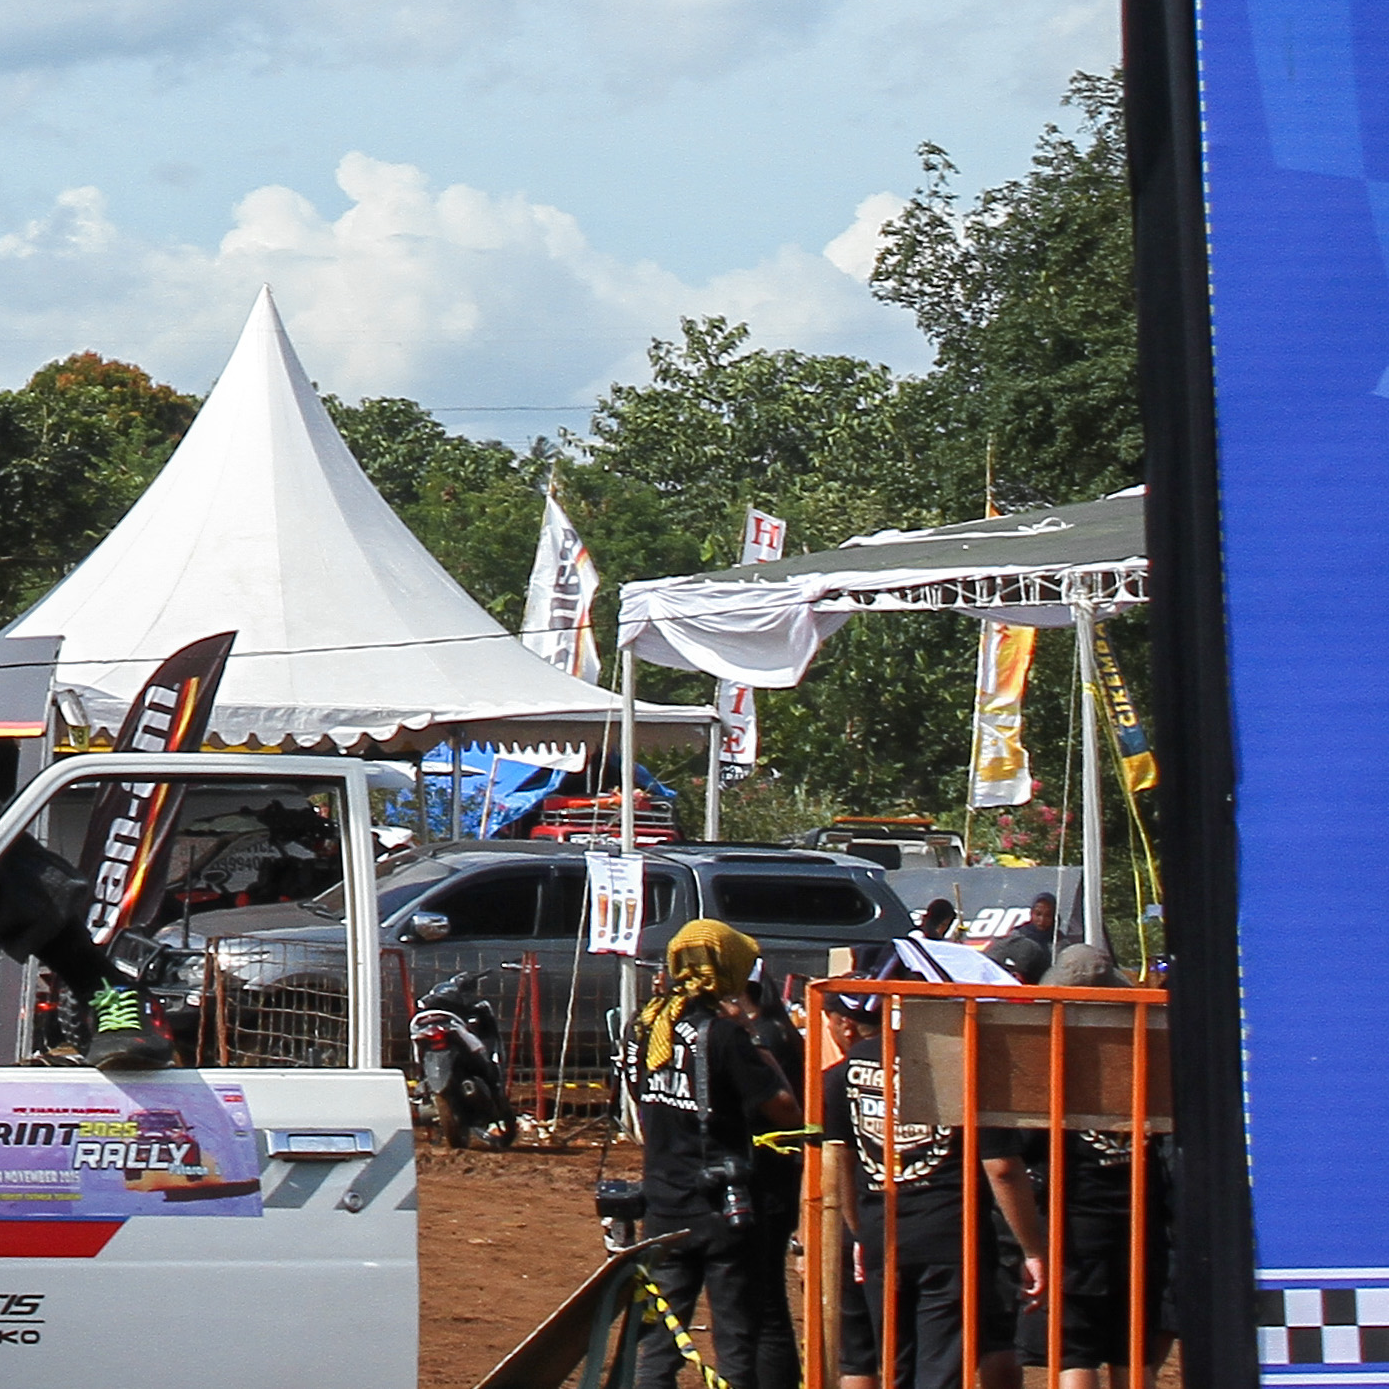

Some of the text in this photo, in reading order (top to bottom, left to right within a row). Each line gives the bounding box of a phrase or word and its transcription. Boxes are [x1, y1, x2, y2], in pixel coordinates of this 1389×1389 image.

[1093, 622, 1138, 728] CIKEMBA
[846, 1065, 886, 1088] CHA
[78, 1120, 139, 1138] 2025
[72, 1141, 192, 1171] RALLY
[3, 1170, 60, 1184] NOVEMBER
